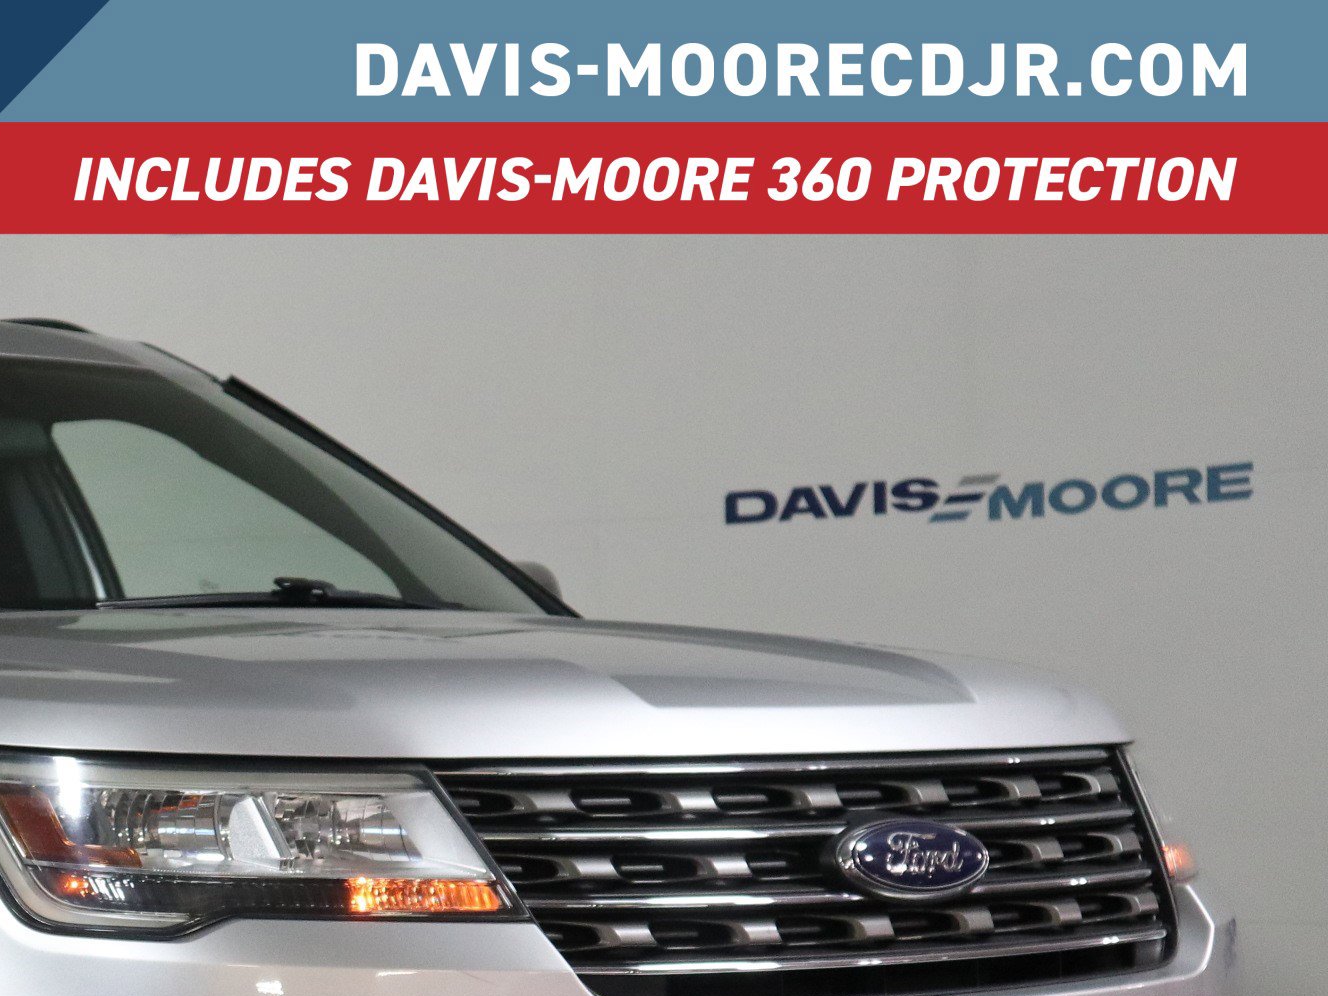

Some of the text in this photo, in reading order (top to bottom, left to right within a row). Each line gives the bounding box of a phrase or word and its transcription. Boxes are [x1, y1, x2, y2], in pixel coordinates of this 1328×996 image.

[725, 461, 1255, 525] DAVIS MOORE
[886, 831, 964, 878] Ford
